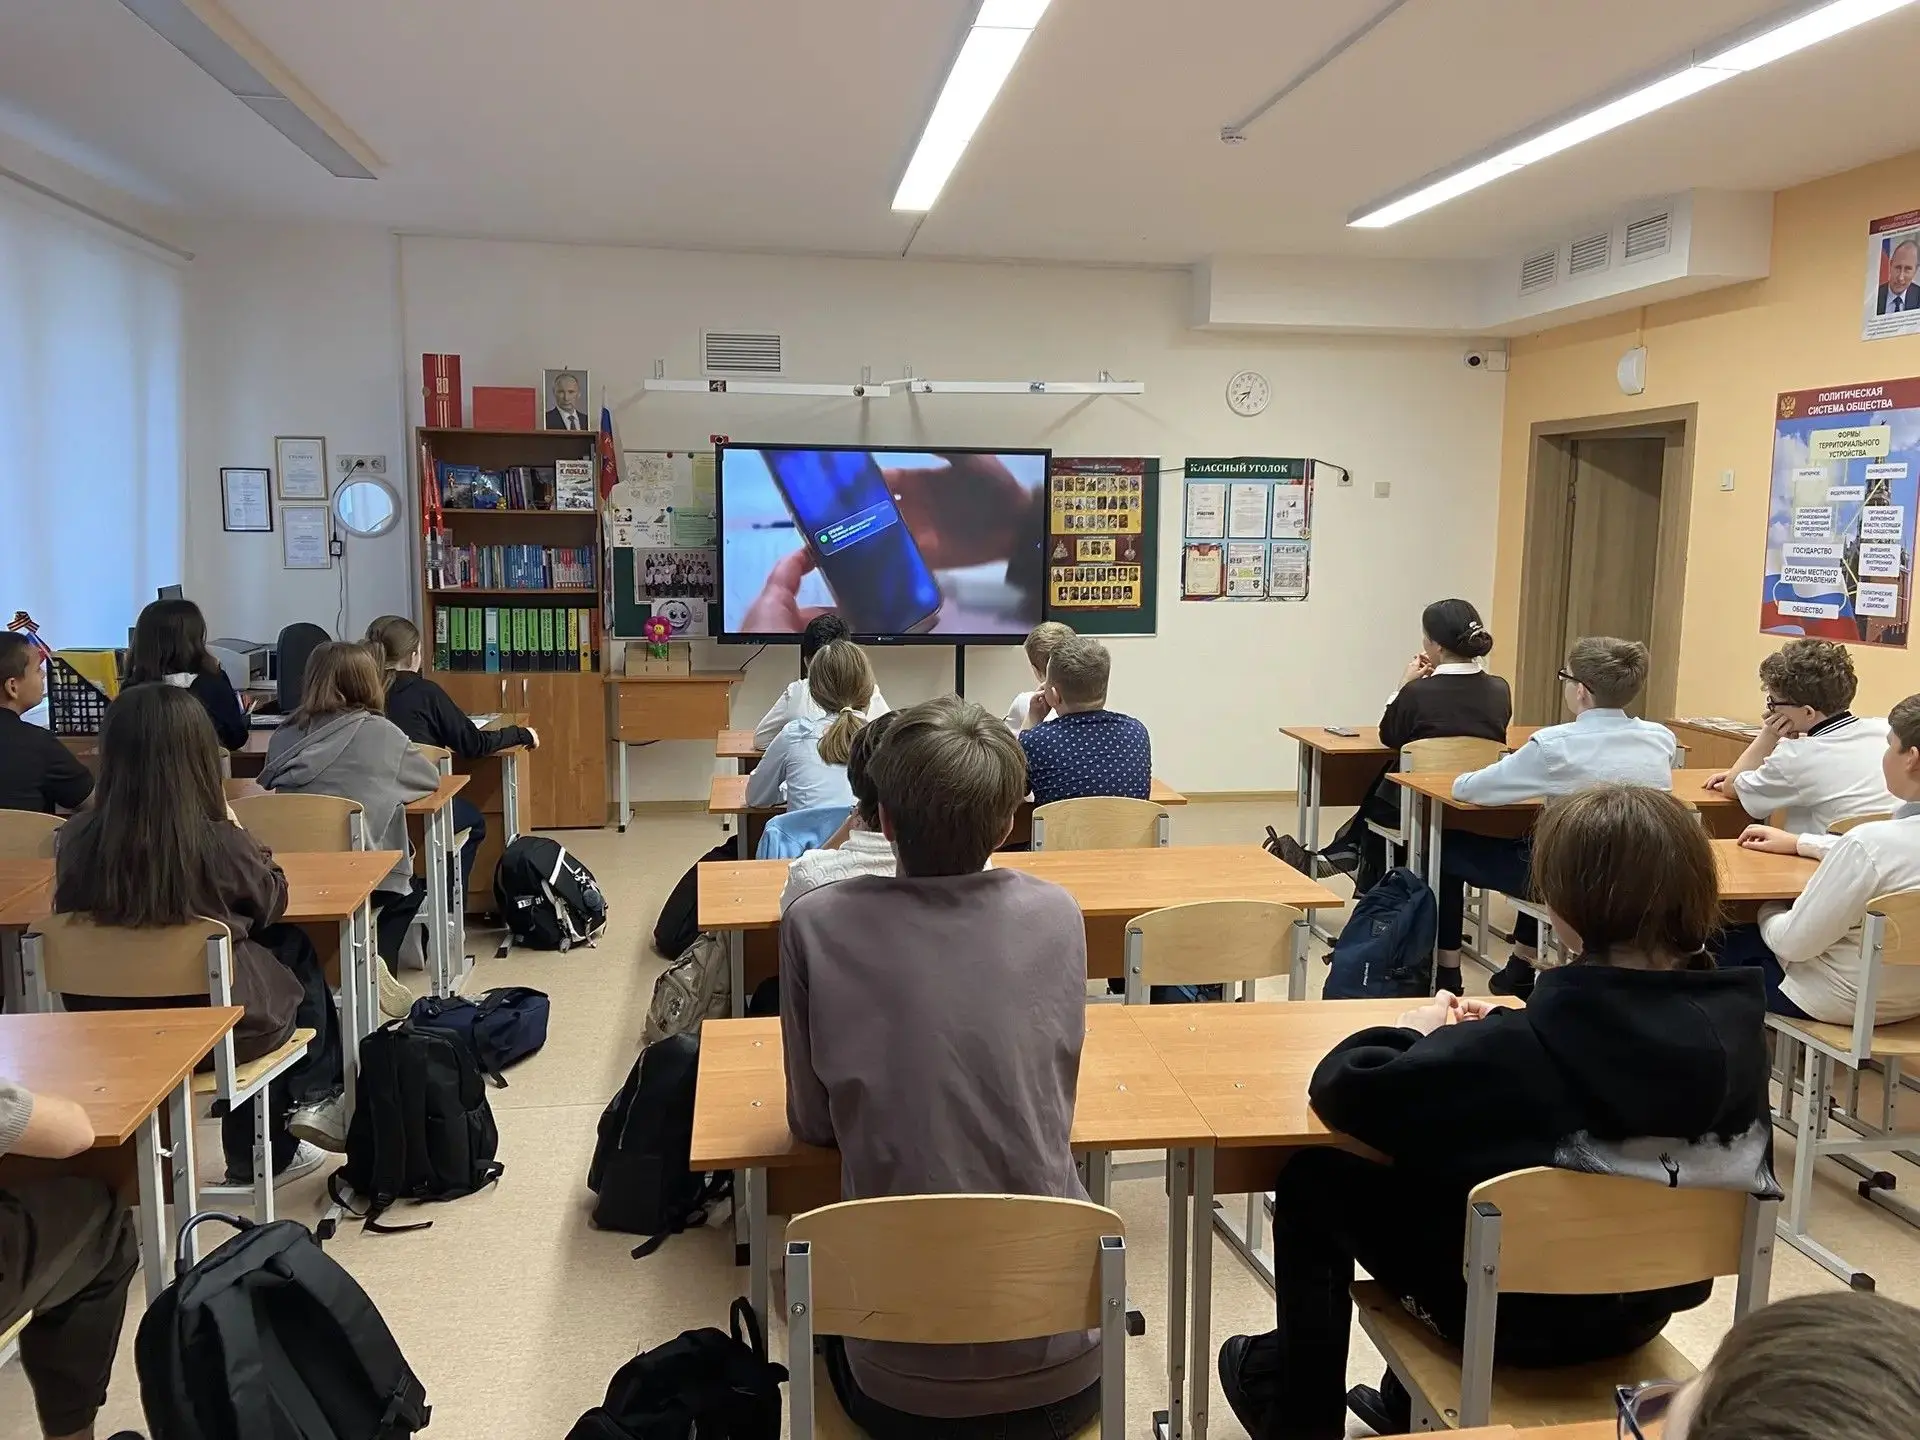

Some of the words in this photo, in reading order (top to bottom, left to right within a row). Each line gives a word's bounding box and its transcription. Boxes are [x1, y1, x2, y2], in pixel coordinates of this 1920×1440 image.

[436, 377, 450, 394] 80
[1818, 386, 1883, 403] ПОЛИТИЧЕСКАЯ
[1808, 401, 1844, 416] СИСТЕМА
[1846, 398, 1893, 412] ОБЩЕСТВА
[1837, 430, 1861, 439] ФОРМЫ
[1818, 438, 1880, 449] ТЕРРИТОРИАЛЬНОГО
[1829, 449, 1867, 459] УСТРОЙСТВА
[1190, 462, 1247, 473] КЛАССНЫЙ
[1248, 464, 1289, 473] УГОЛОК
[1792, 546, 1833, 556] ГОСУДАРСТВО
[1784, 567, 1808, 576] ОРГАНЫ
[1808, 568, 1839, 577] МЕСТНОГО
[1784, 575, 1837, 584] САМОУПРАВЛЕНИЯ
[1792, 605, 1824, 615] ОБЩЕСТВО
